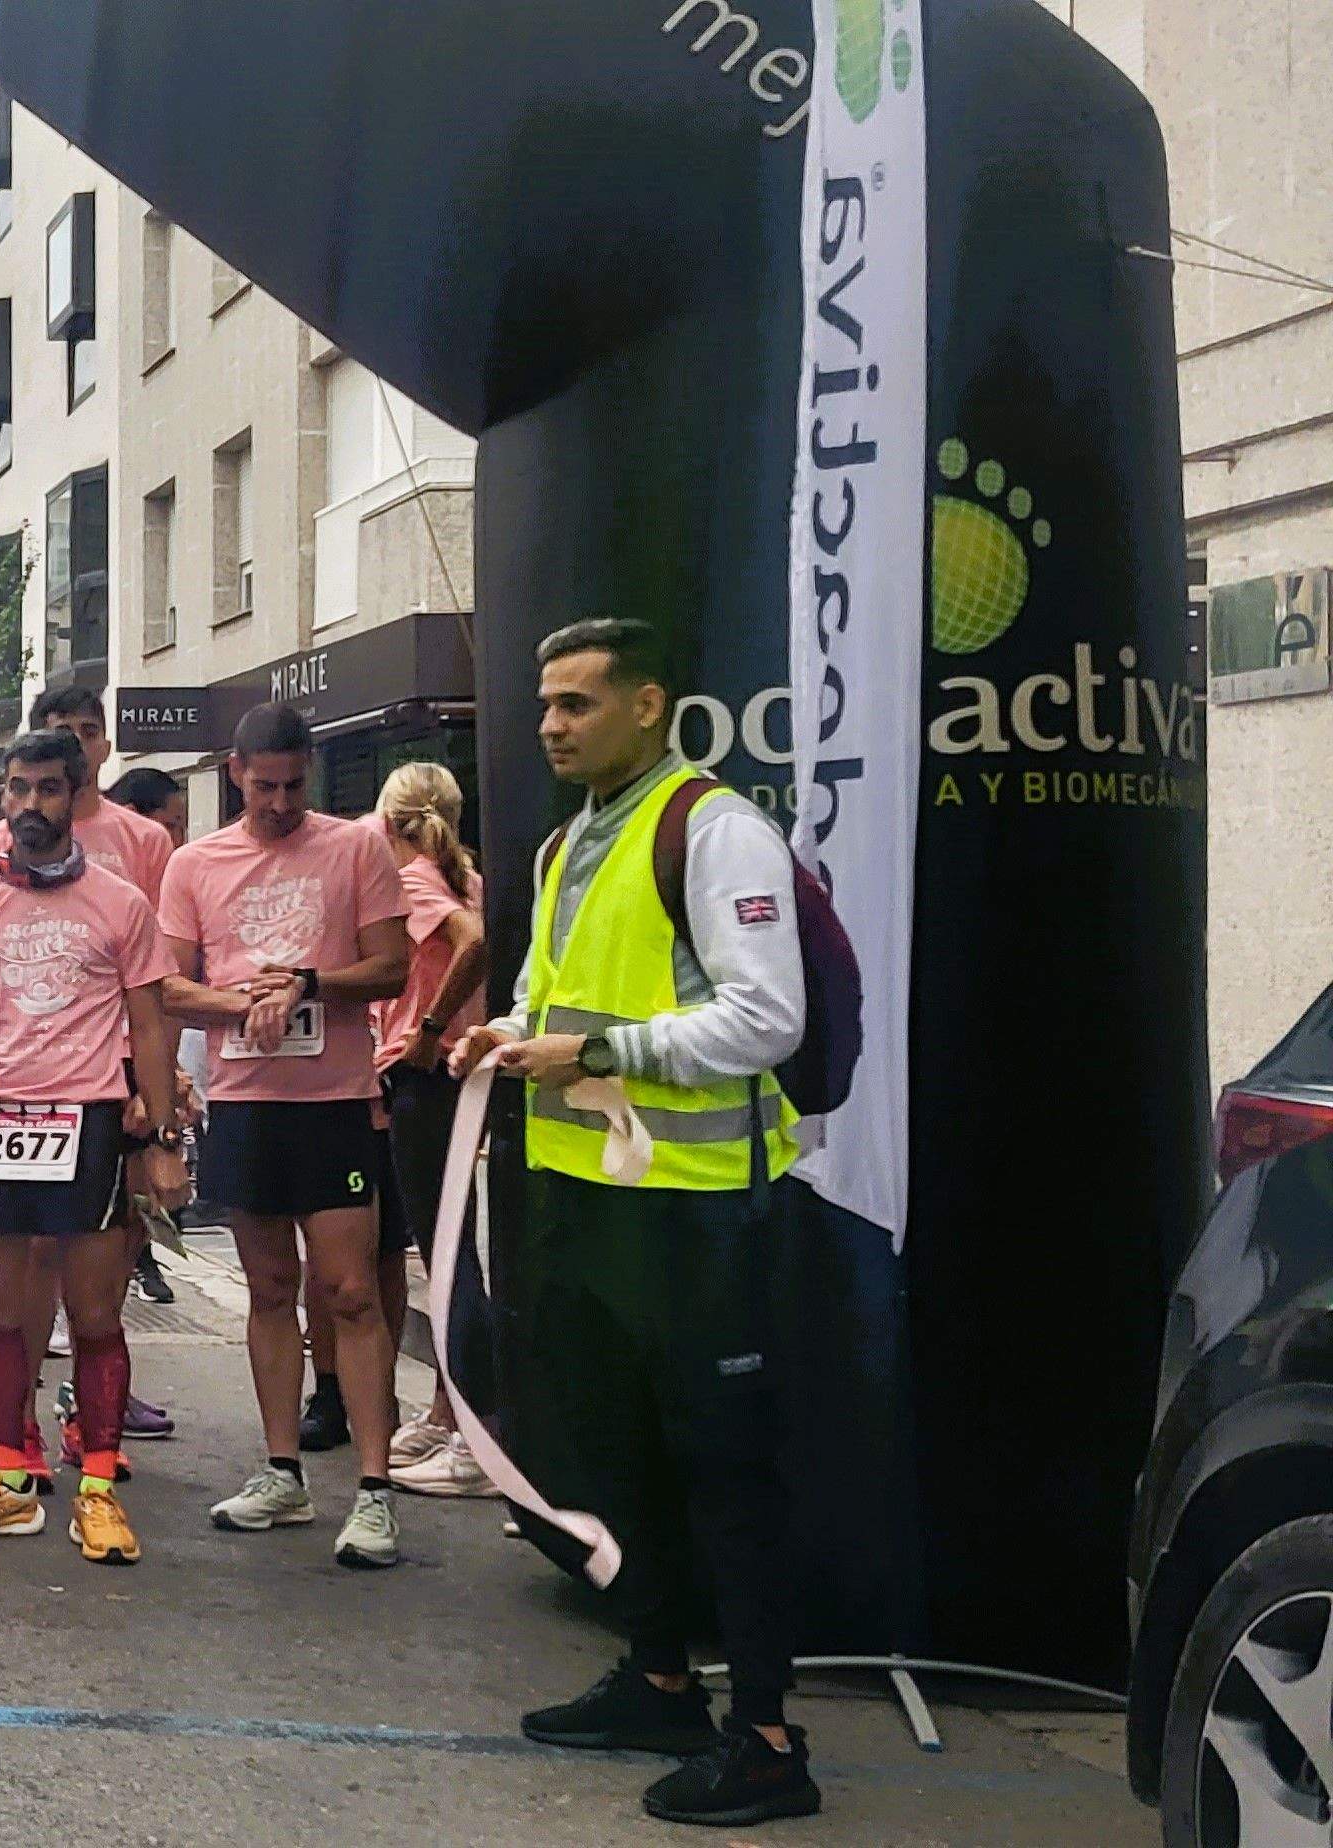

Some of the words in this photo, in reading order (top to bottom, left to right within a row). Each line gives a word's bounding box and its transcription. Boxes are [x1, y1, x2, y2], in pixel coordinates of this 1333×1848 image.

[270, 653, 328, 701] MIRATE
[120, 707, 198, 724] MIRATE
[980, 771, 1004, 804] Y
